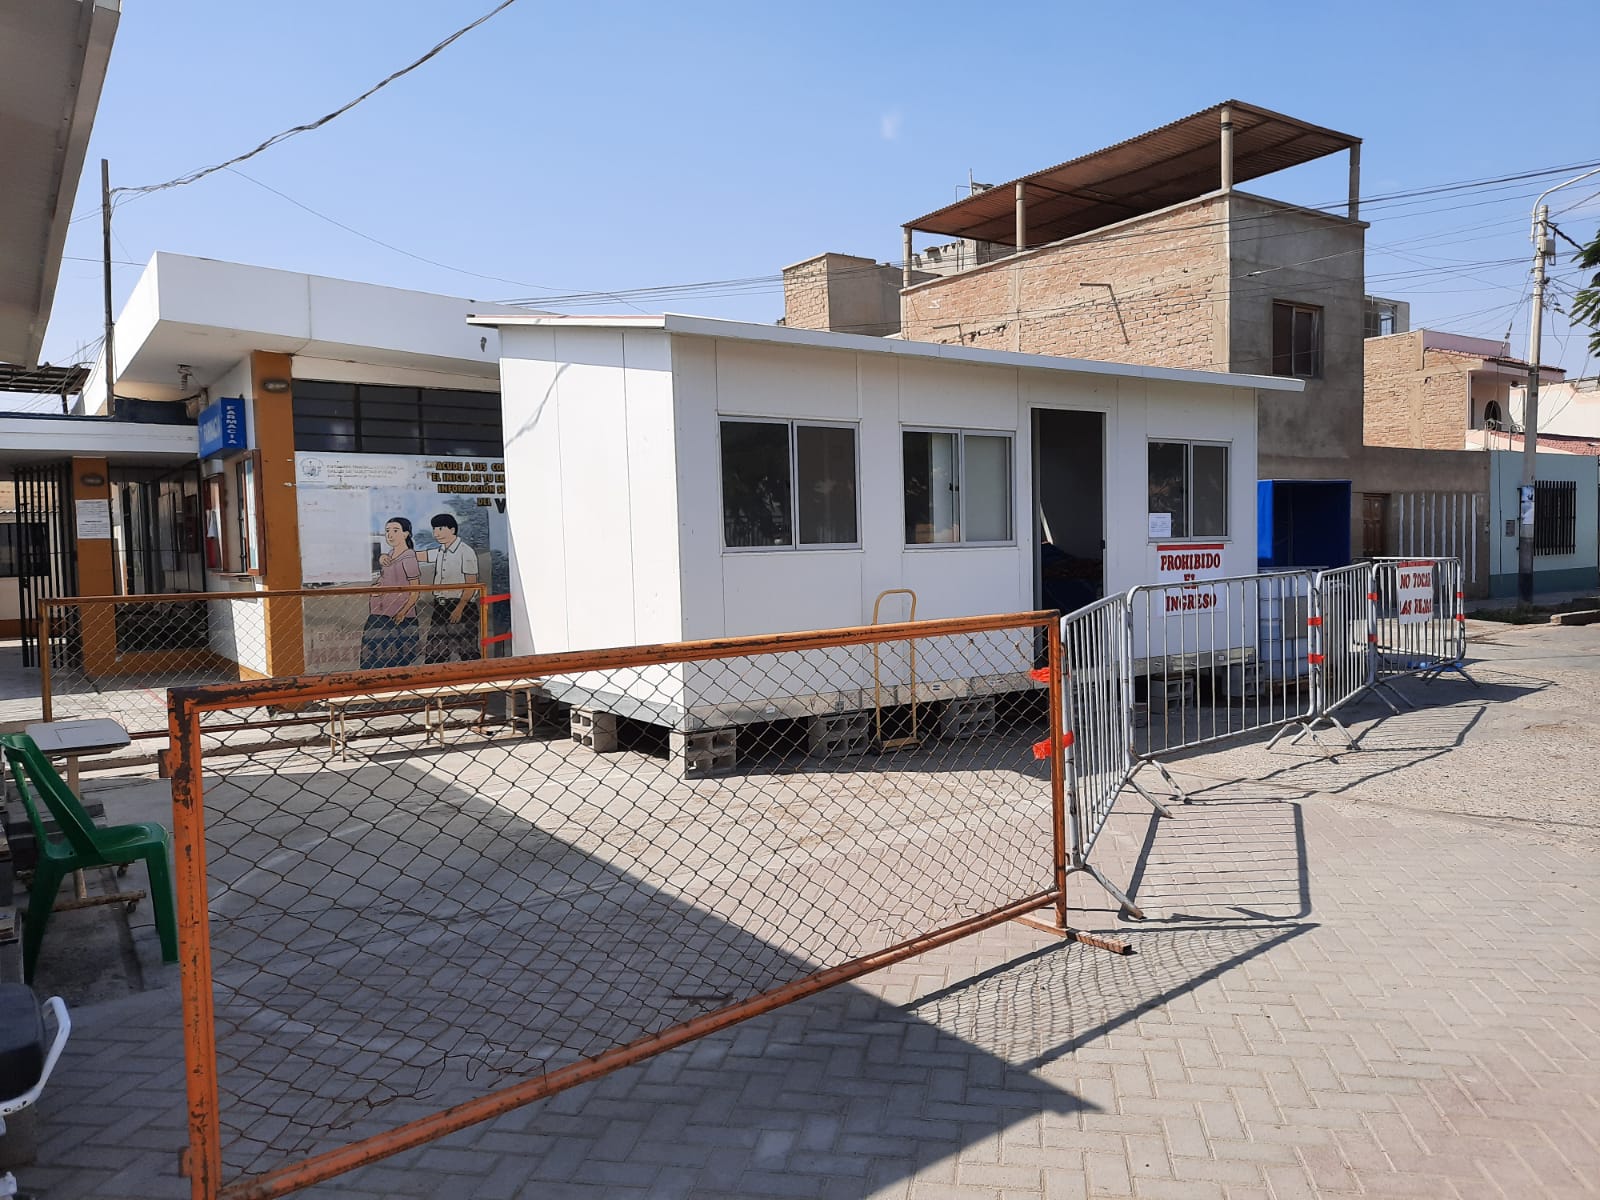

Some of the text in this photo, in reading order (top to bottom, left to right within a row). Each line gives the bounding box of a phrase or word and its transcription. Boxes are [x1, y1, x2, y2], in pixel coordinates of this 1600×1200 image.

[226, 405, 238, 445] FARMACIA
[436, 462, 463, 471] ACUDE
[464, 462, 472, 472] A
[472, 462, 488, 472] TUS
[432, 473, 441, 482] EL
[443, 473, 469, 482] INICIO
[471, 474, 482, 482] DE
[483, 474, 494, 483] TU
[477, 497, 492, 506] DEL
[1160, 553, 1221, 571] PROHIBIDO
[1183, 573, 1197, 589] EL
[1400, 573, 1410, 589] NO
[1165, 593, 1217, 612] INGRESO
